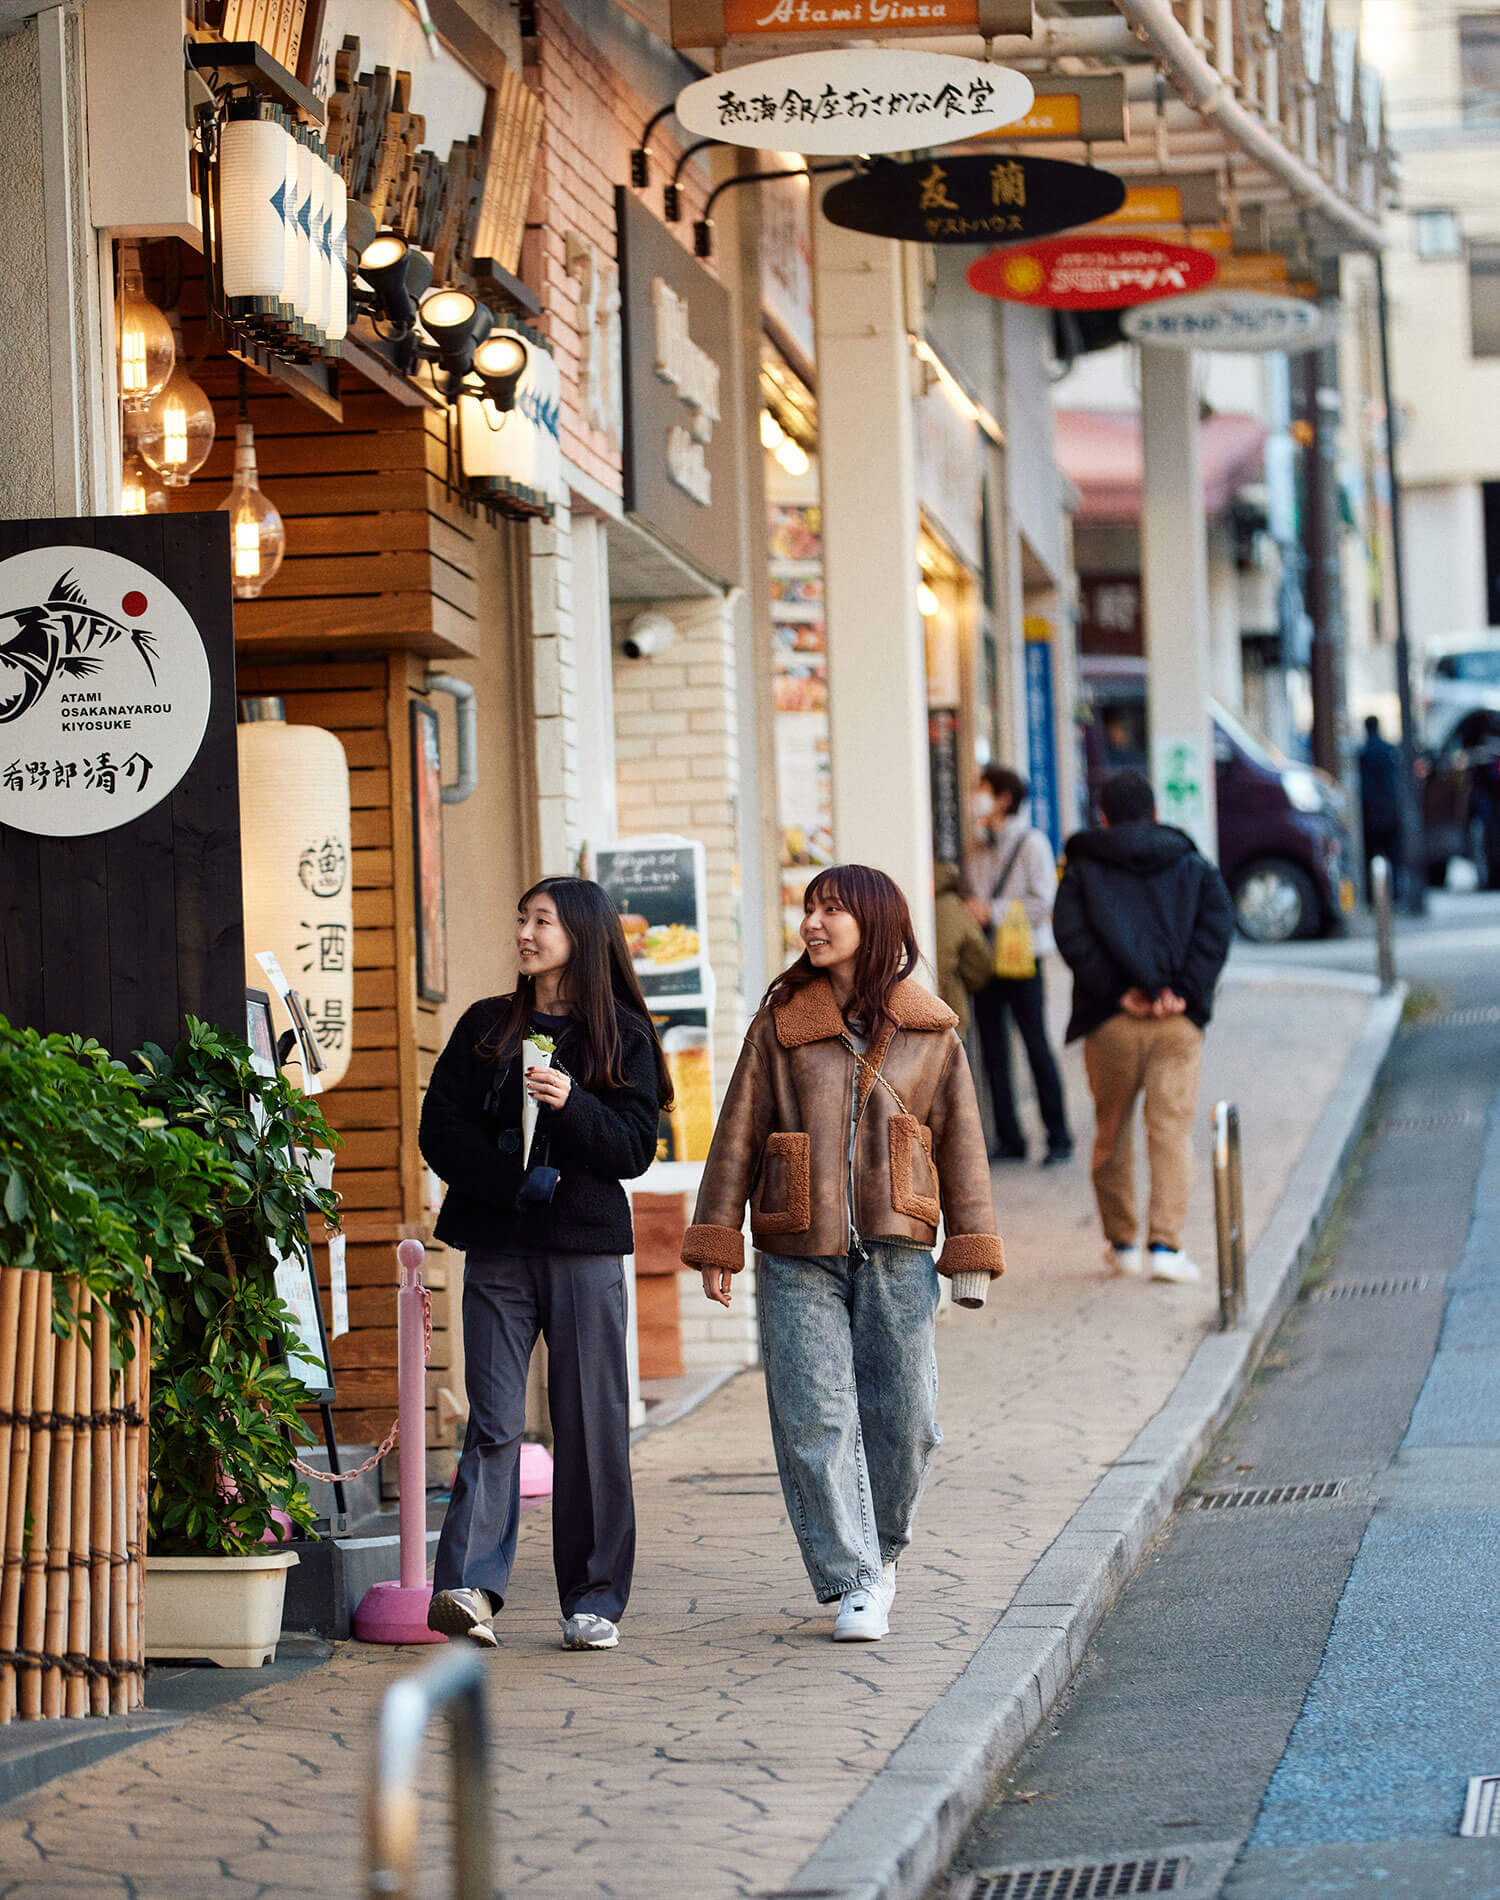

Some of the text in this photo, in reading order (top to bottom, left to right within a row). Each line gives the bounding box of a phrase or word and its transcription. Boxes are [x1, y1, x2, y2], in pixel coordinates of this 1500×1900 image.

[757, 0, 947, 26] Atami Ginza
[717, 76, 995, 125] 熱海銀座おさかな食堂
[61, 692, 102, 703] ATAMI
[61, 703, 172, 717] OSAKANAYAROU
[62, 719, 132, 732] KIYOSUKE
[3, 751, 154, 795] 肴野郎清介
